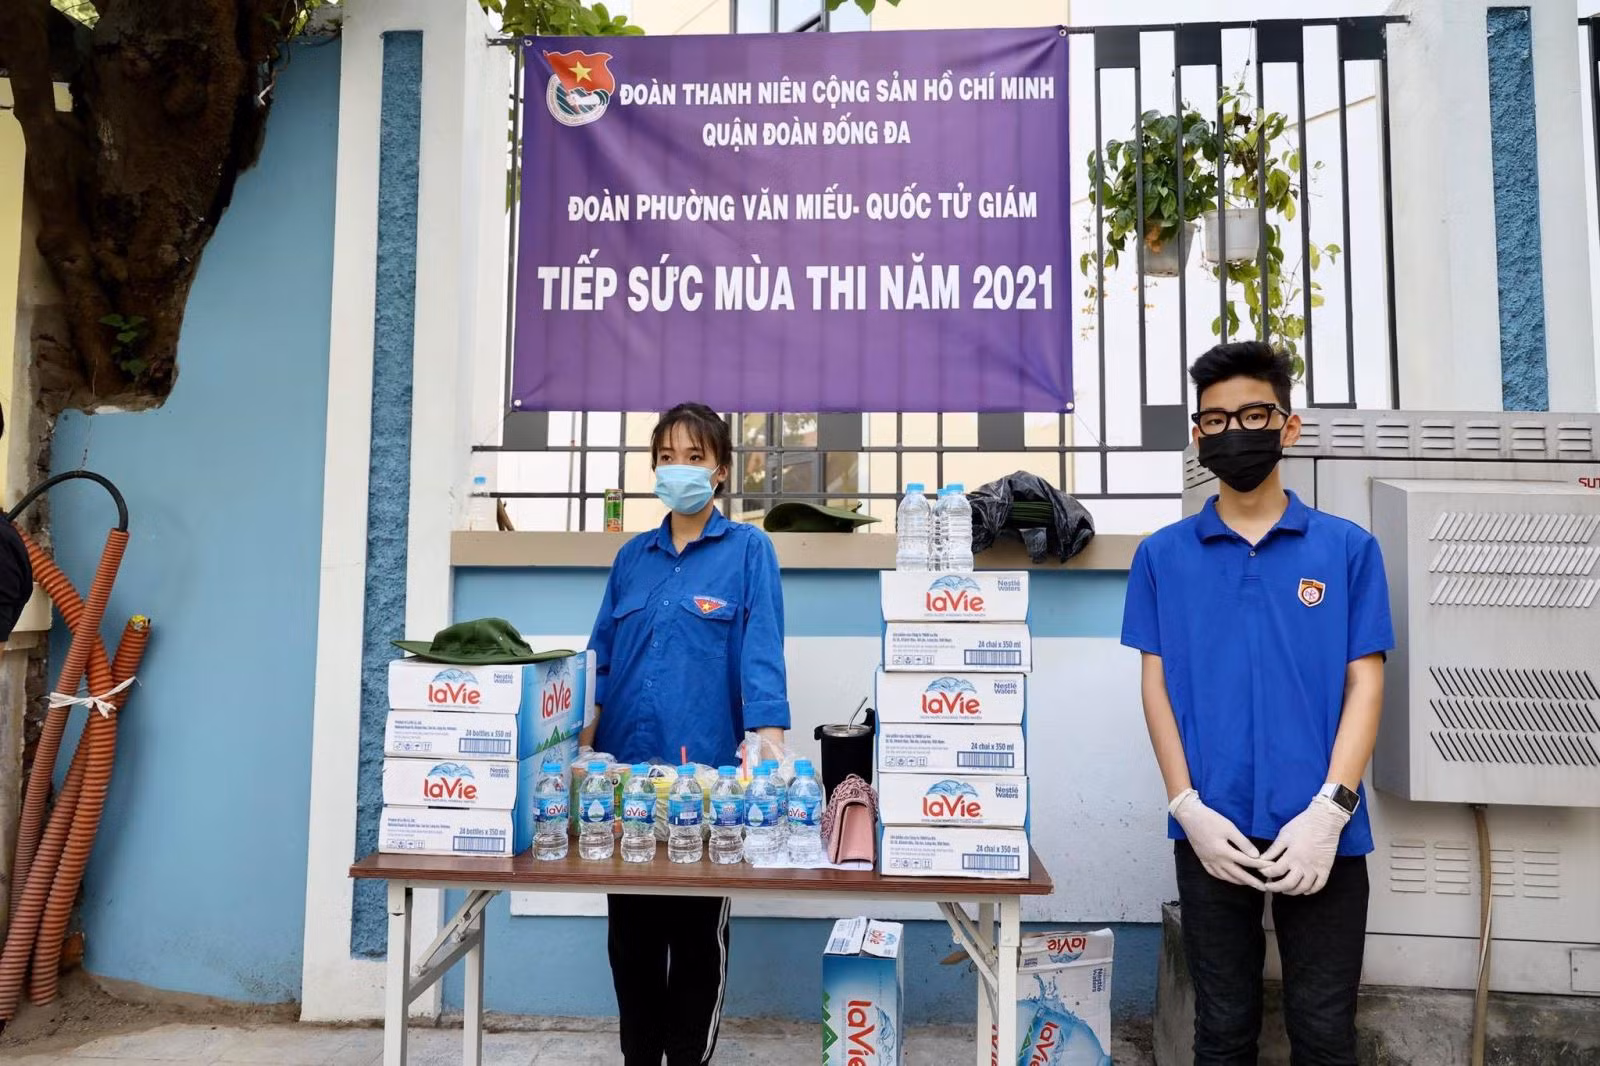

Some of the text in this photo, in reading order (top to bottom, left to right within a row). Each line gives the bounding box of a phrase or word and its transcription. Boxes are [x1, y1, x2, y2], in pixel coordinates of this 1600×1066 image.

[620, 70, 1053, 109] ĐOÀN THANH NIÊN CỘNG SẢN HỒ CHÍ MINH
[703, 112, 910, 151] QUẬN ĐOÀN ĐỐNG ĐA
[568, 182, 1036, 221] ĐOÀN PHƯỜNG VĂN MIẾU- QUỐC TỬ GIÁM
[538, 249, 1052, 311] TIẾP SỨC MÙA THI NĂM 2021
[926, 590, 984, 612] laVie
[986, 640, 998, 648] chai
[428, 683, 480, 704] laVie
[543, 680, 571, 718] laVie
[922, 692, 980, 714] laVie
[1006, 743, 1014, 751] ml
[424, 777, 477, 799] laVie
[626, 807, 647, 816] aVie
[789, 808, 808, 818] aVie
[923, 794, 981, 817] laVie
[984, 845, 995, 853] chai
[1012, 845, 1020, 853] ml
[1047, 937, 1086, 953] laVie
